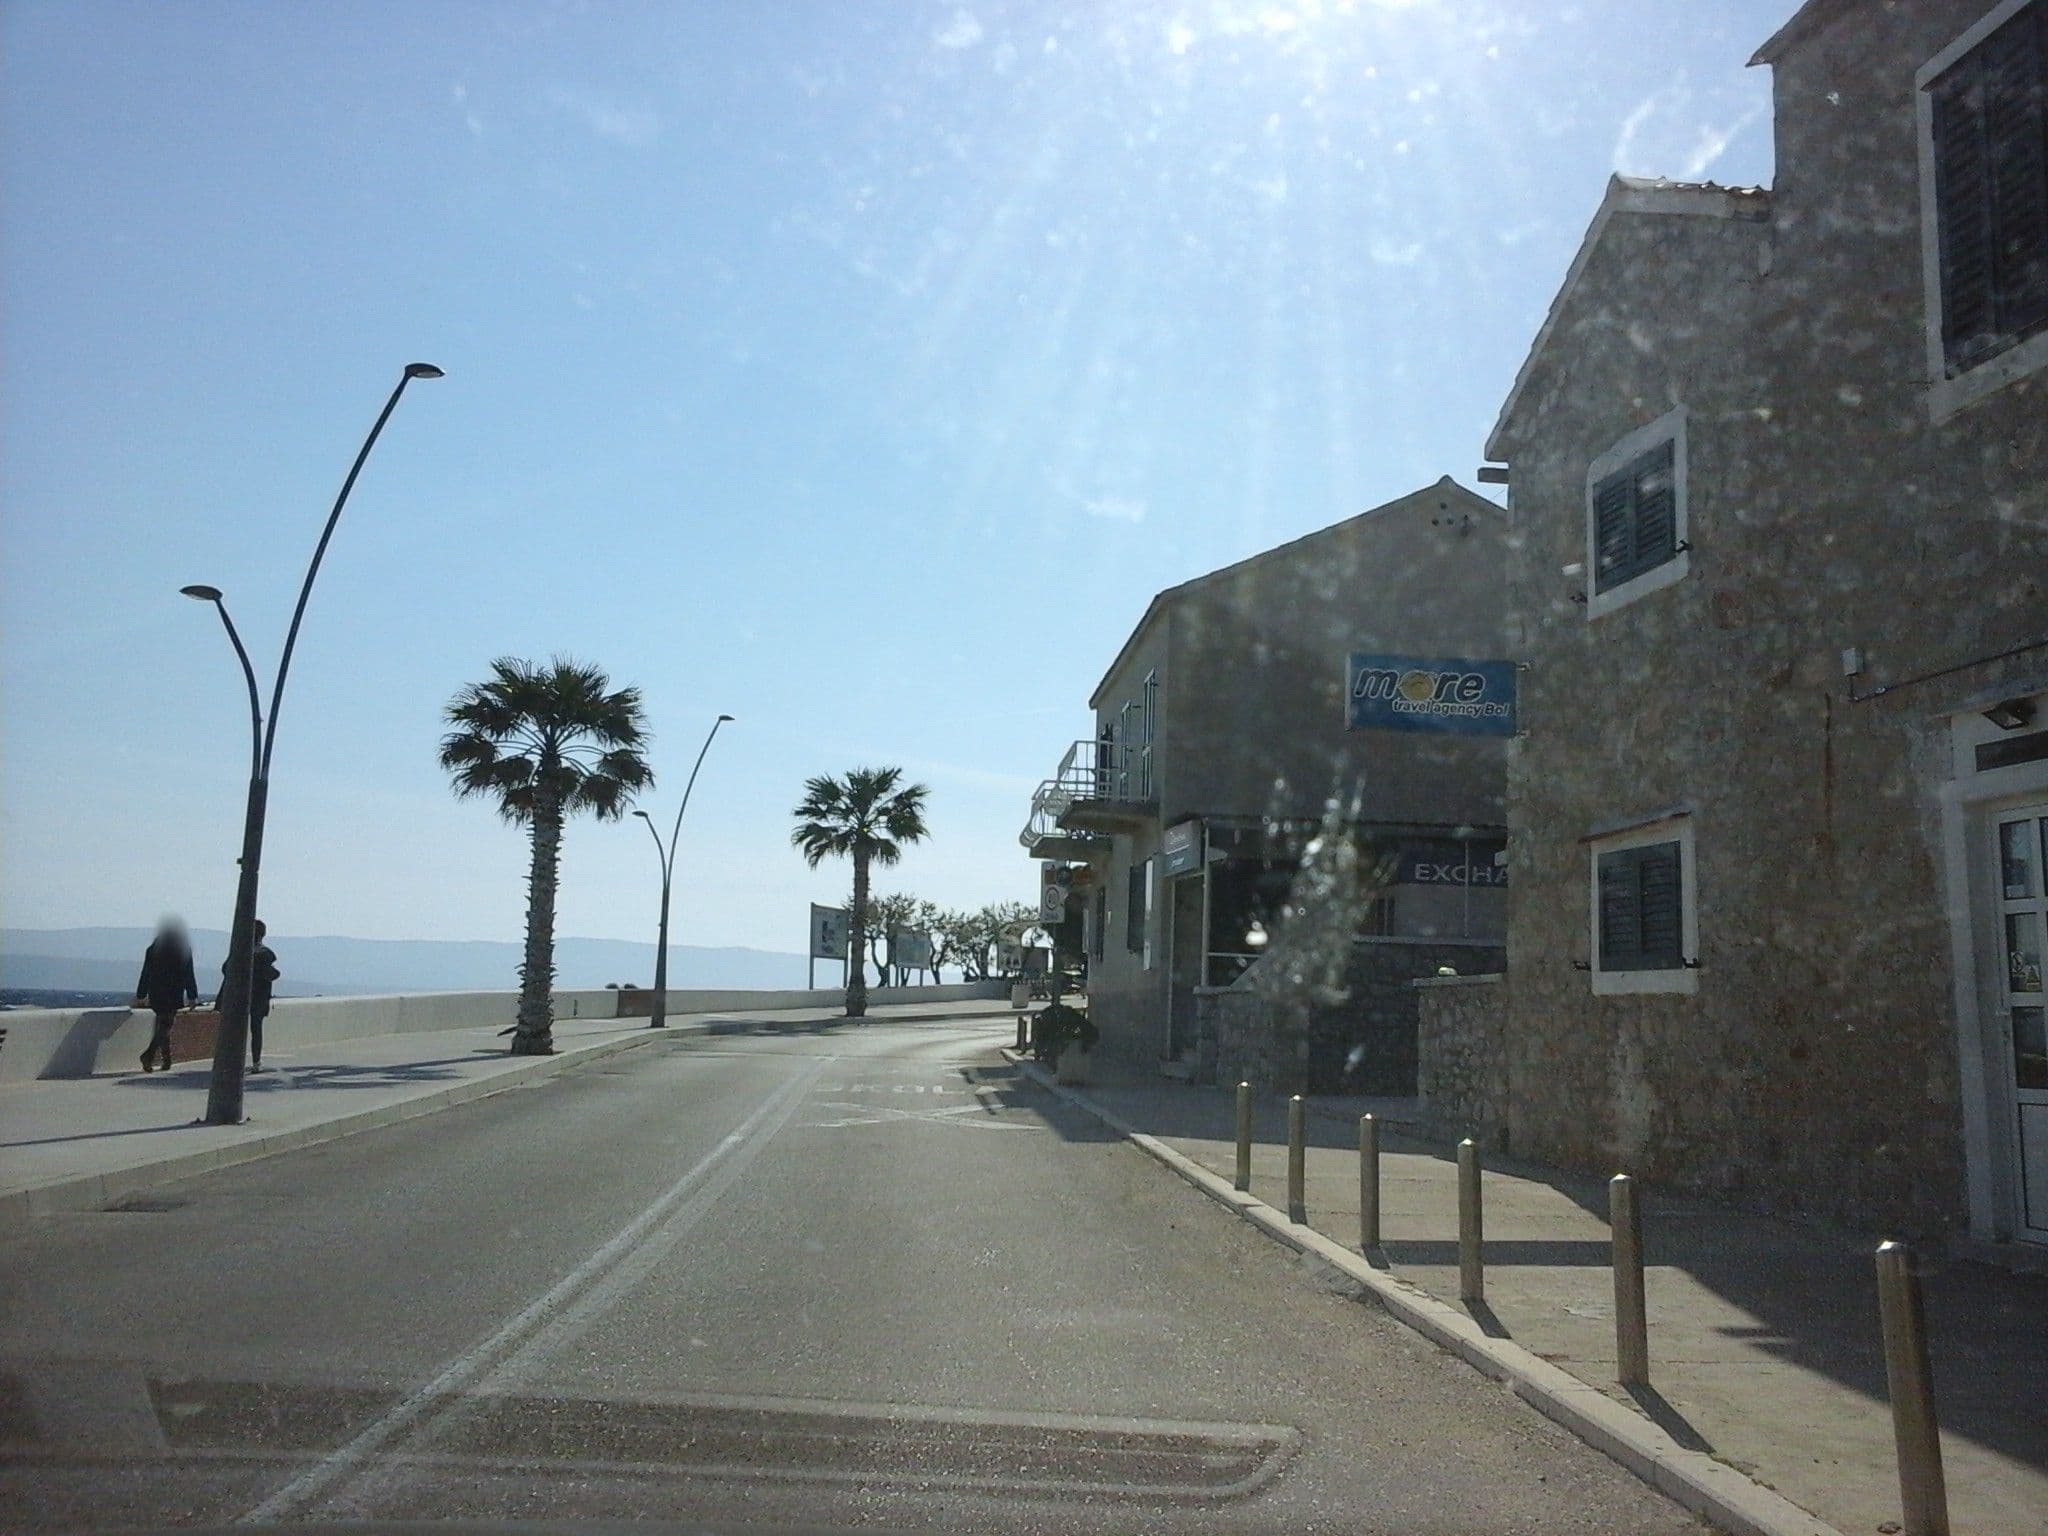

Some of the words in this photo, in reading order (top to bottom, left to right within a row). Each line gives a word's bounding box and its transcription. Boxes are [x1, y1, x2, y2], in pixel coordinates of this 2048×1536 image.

[1353, 668, 1486, 702] more
[1392, 698, 1431, 713] travel
[1433, 701, 1481, 718] agency
[1484, 702, 1509, 717] Bol
